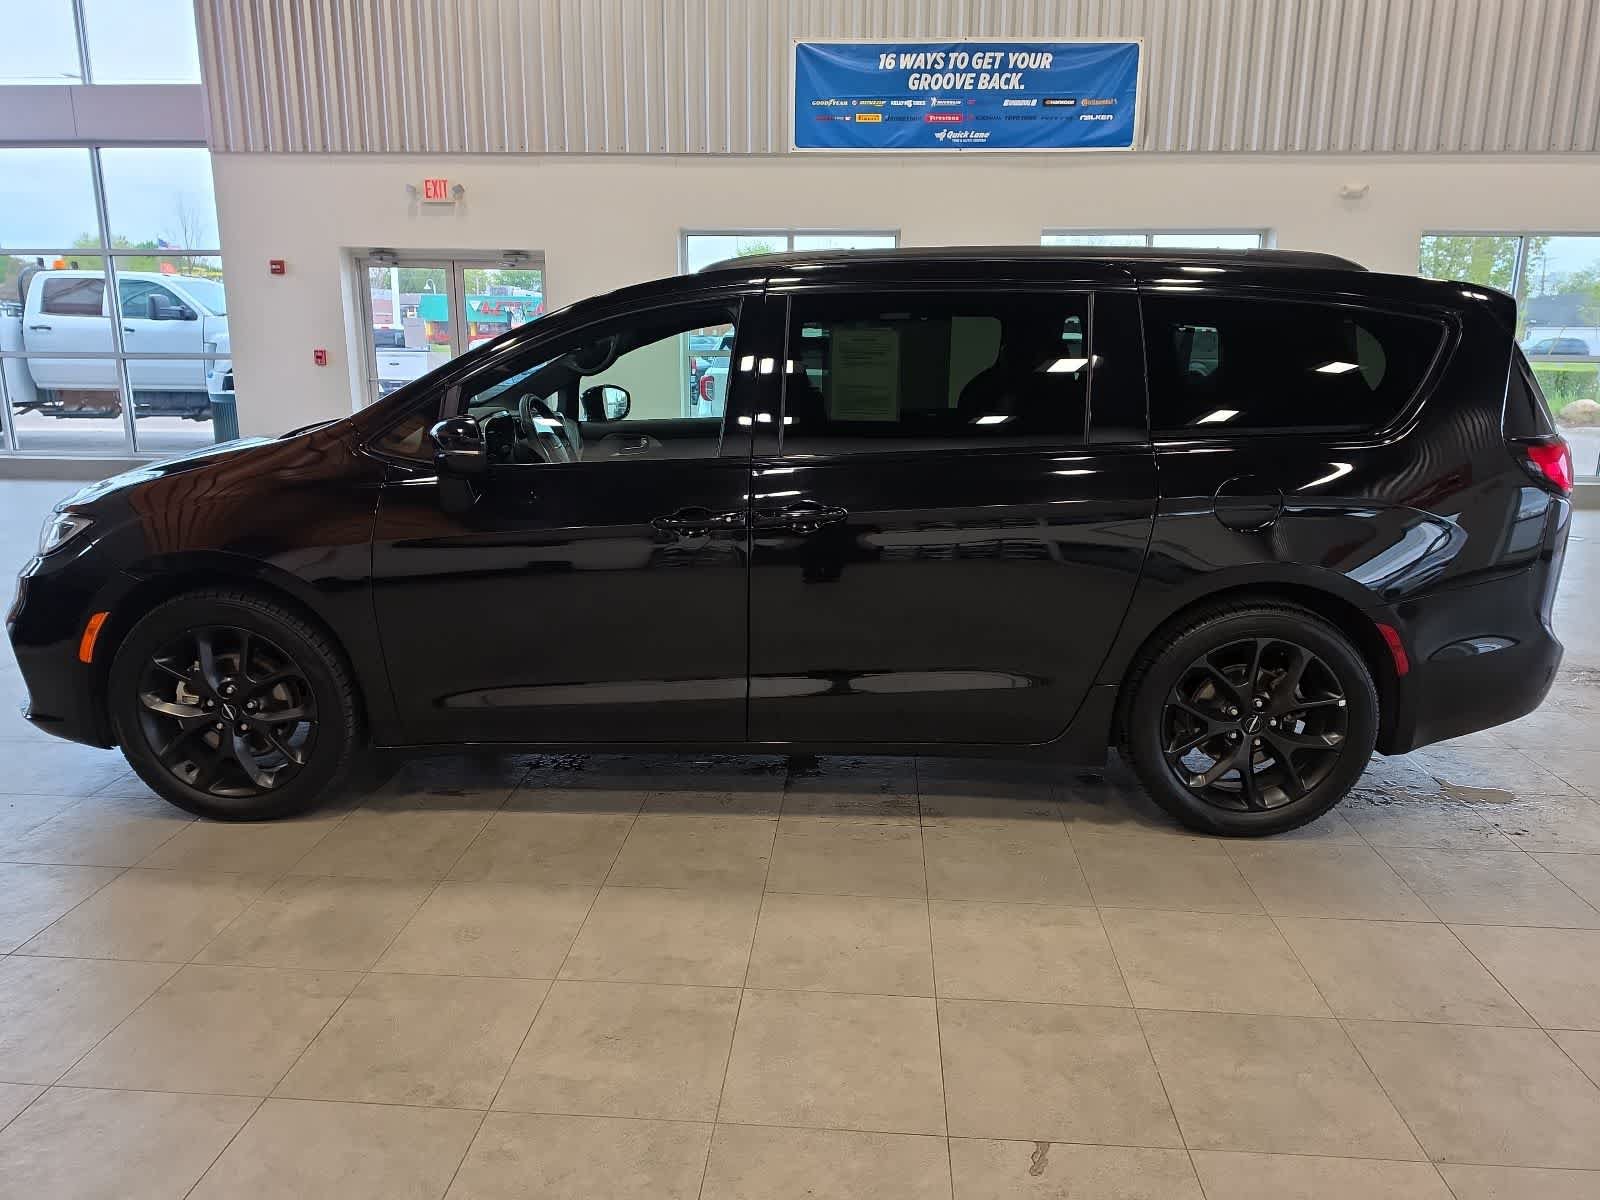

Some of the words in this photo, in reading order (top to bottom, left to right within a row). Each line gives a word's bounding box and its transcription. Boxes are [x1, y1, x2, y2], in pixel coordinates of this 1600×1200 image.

[879, 53, 896, 70] 16
[899, 52, 945, 70] WAYS
[949, 52, 969, 70] TO
[971, 52, 1004, 70] GET
[1008, 52, 1053, 70] YOUR
[908, 73, 976, 90] GROOVE
[978, 73, 1025, 90] BACK.
[947, 130, 970, 139] Quick
[970, 130, 990, 138] Lane
[424, 180, 447, 199] EXIT
